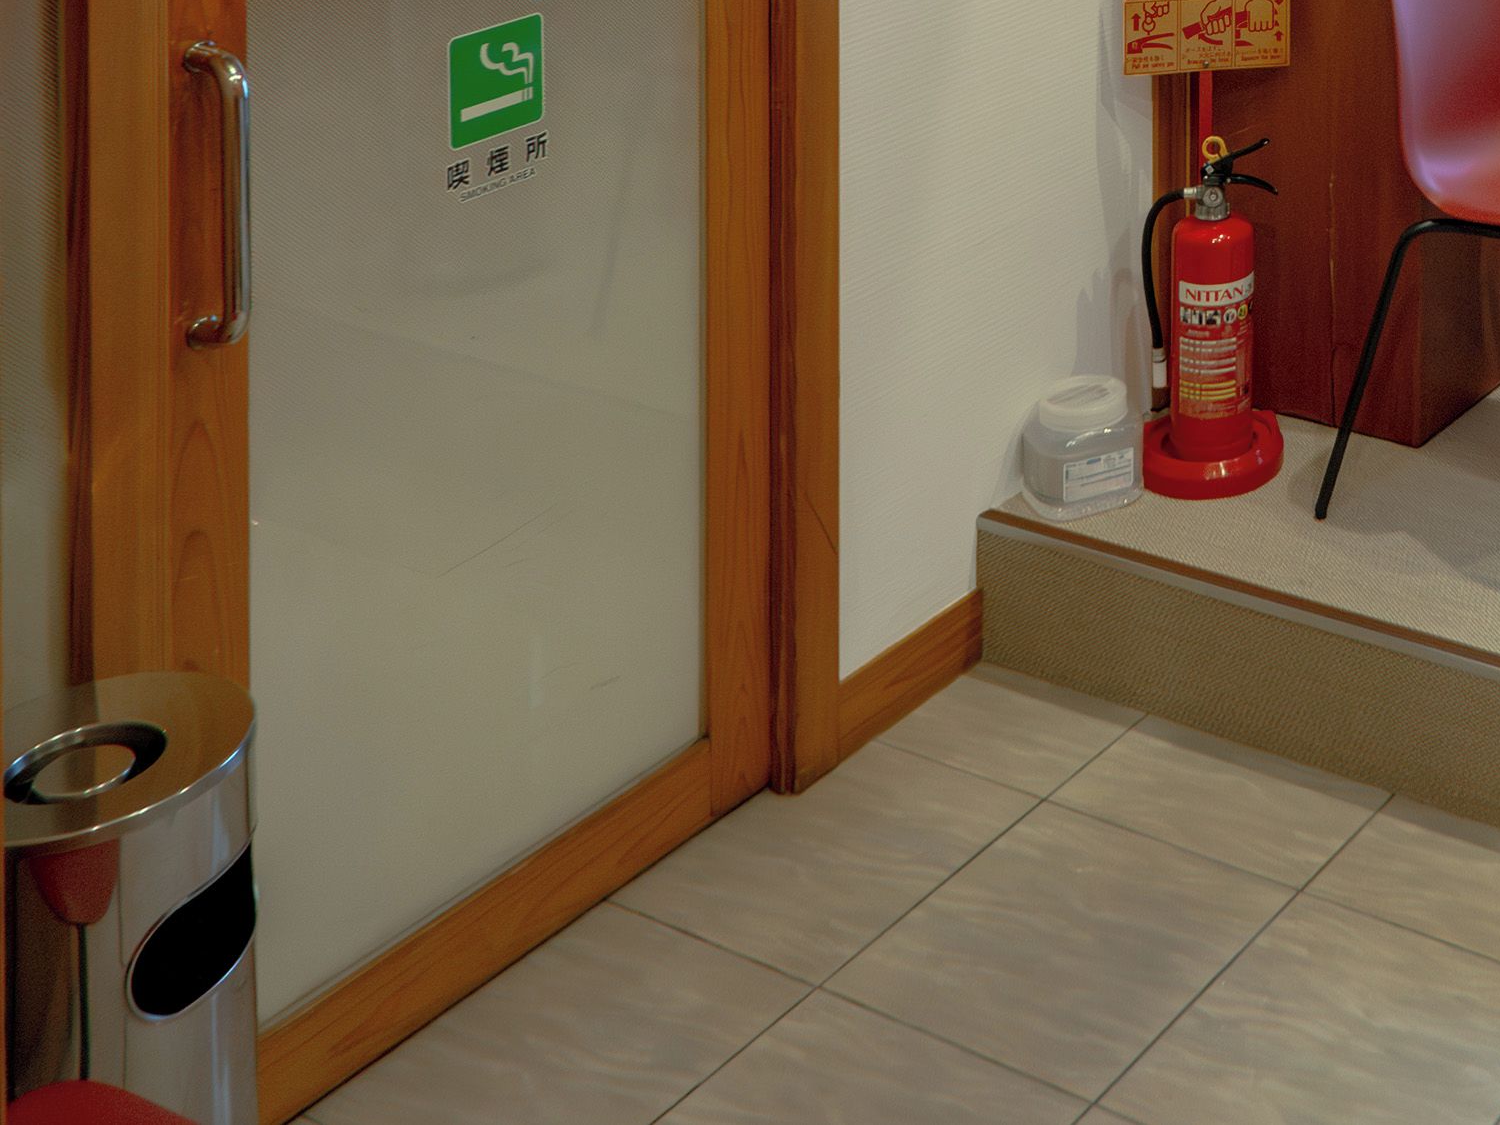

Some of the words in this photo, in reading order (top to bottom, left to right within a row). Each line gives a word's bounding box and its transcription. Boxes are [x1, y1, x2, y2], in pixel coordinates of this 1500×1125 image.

[447, 131, 548, 190] 喫煙所
[460, 177, 508, 202] SMOKING
[509, 167, 537, 184] AREA
[1185, 286, 1244, 303] NITTAN
